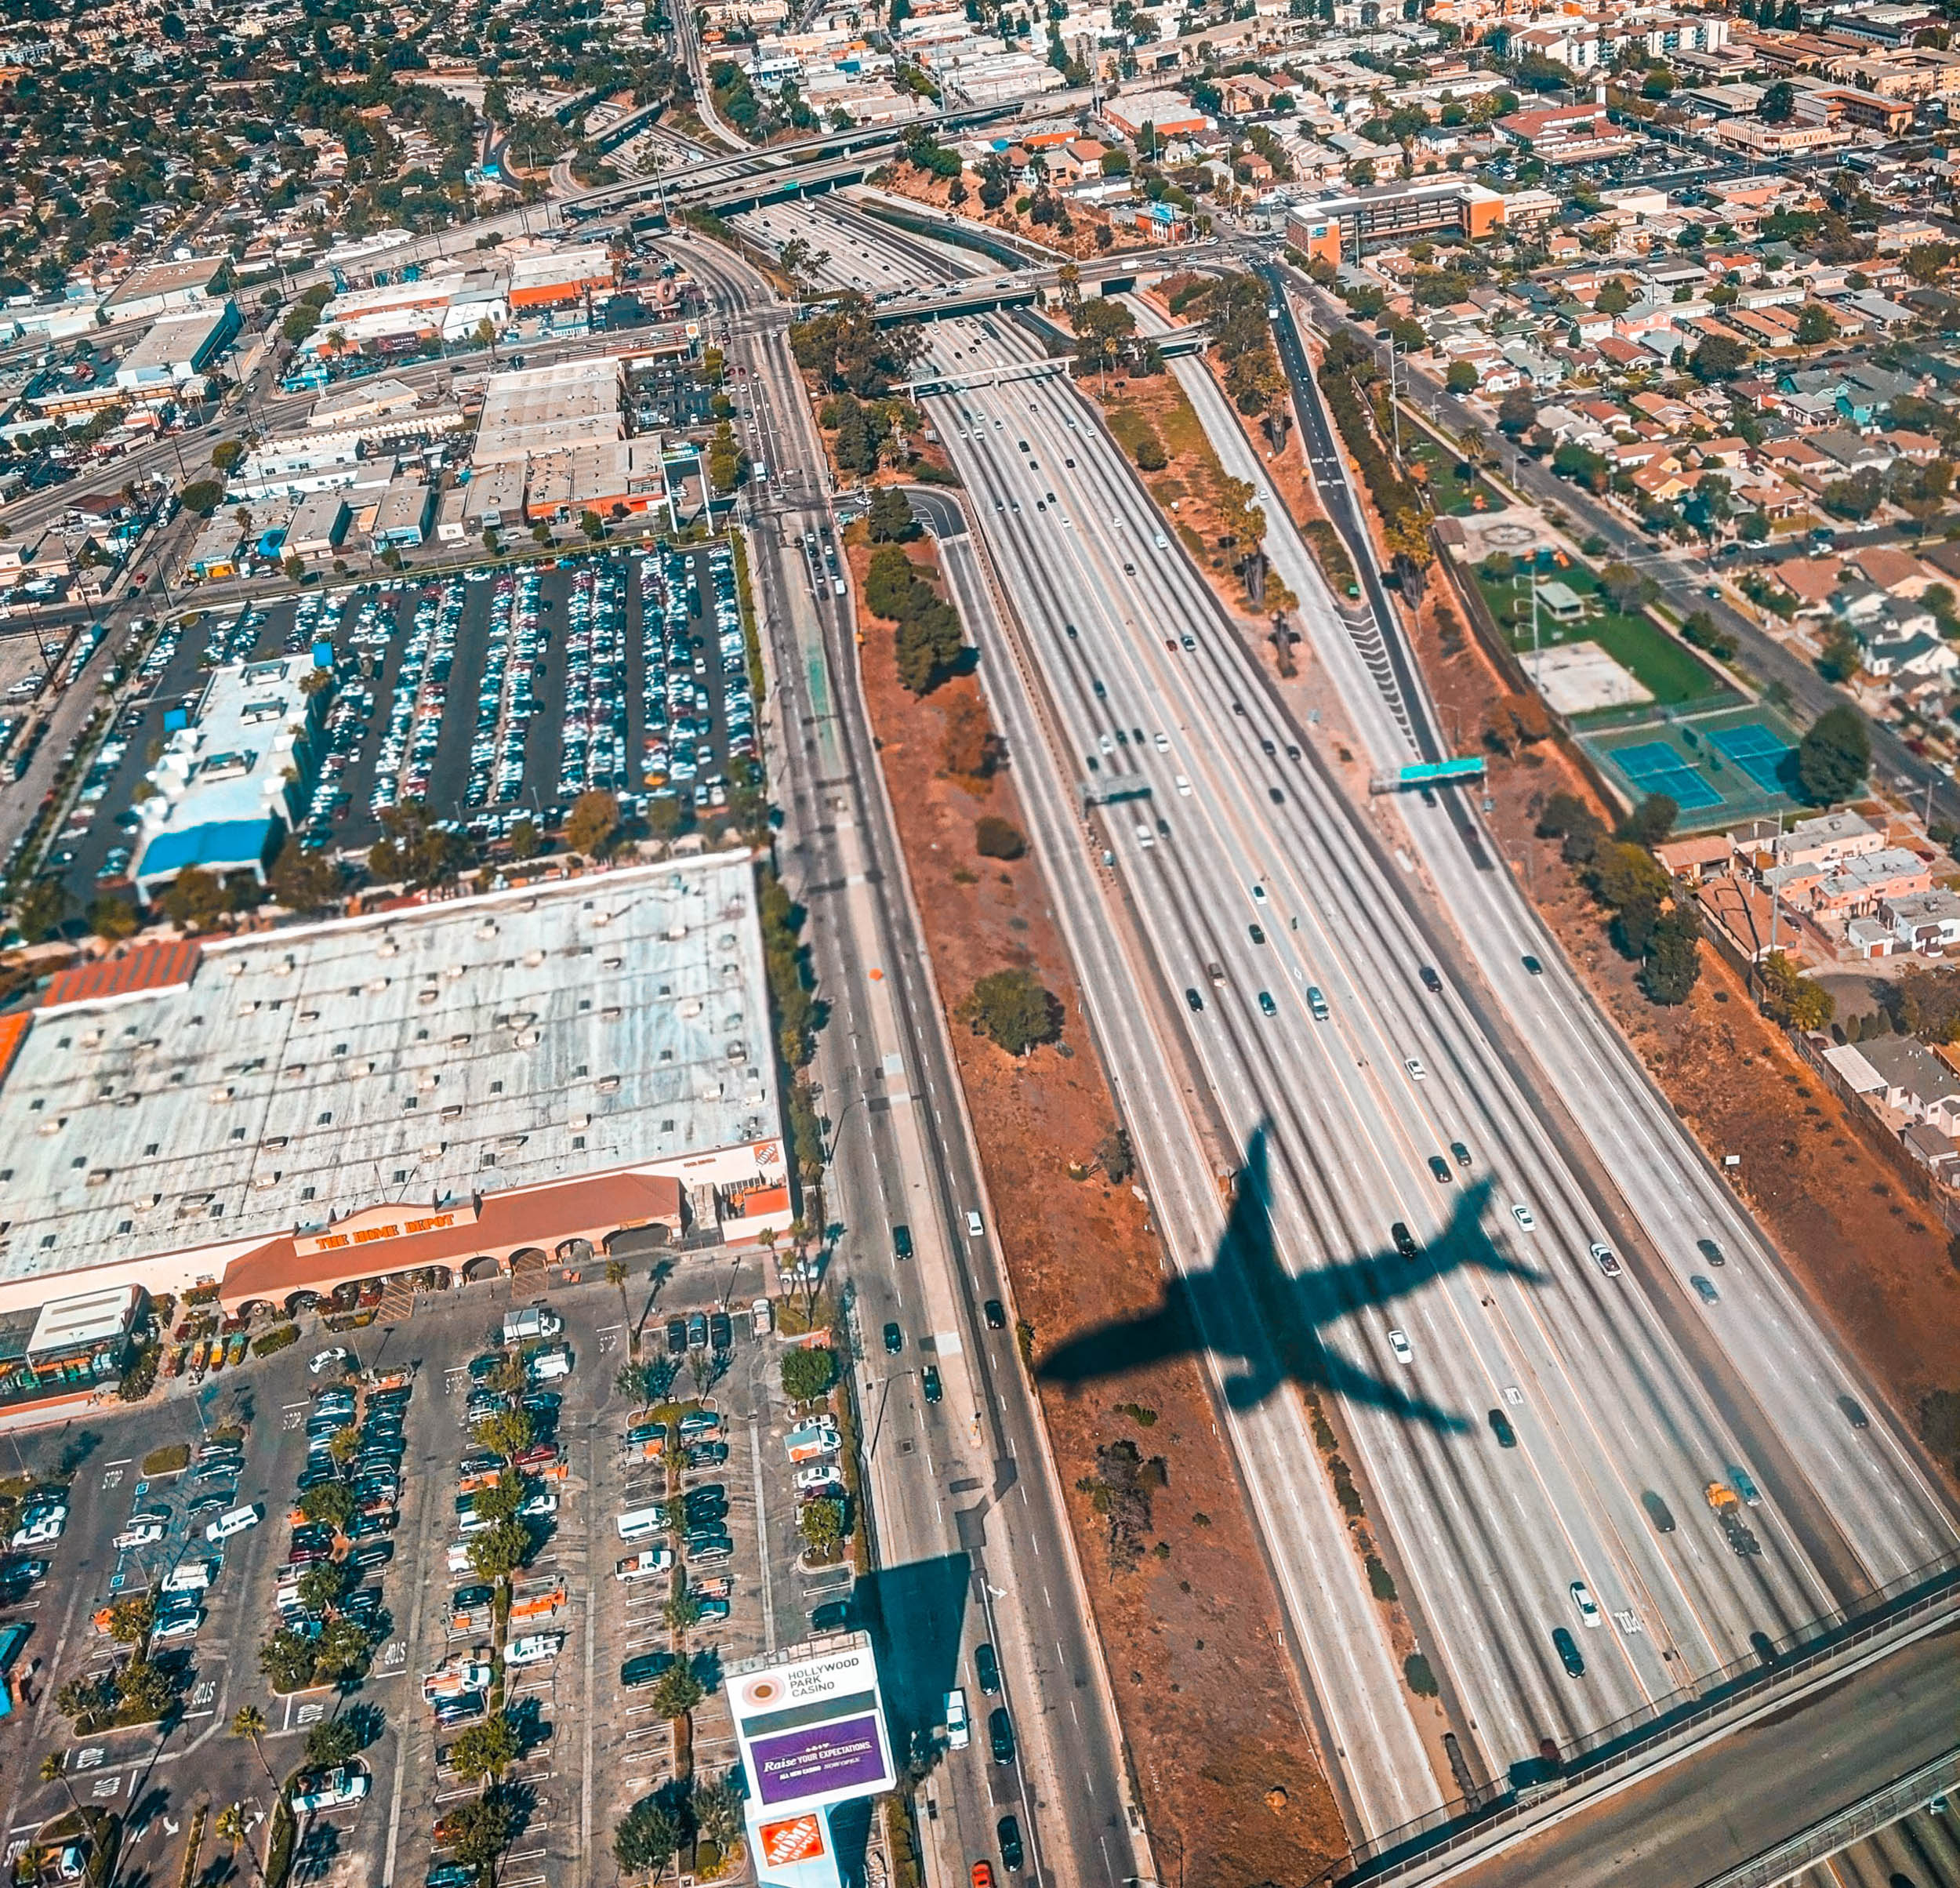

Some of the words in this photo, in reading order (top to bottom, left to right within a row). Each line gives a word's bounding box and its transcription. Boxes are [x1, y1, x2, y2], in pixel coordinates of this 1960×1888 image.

[315, 1233, 349, 1250] THE
[353, 1225, 400, 1244] HOME
[404, 1214, 454, 1233] DEPOT
[384, 1641, 406, 1665] STOP
[788, 1657, 859, 1680] HOLLYWOOD
[192, 1680, 216, 1705] STOP
[790, 1675, 821, 1689] PARK
[792, 1682, 835, 1697] CASINO
[297, 1704, 325, 1723] STOP
[76, 1748, 105, 1769] STOP
[764, 1758, 797, 1774] Raise
[797, 1752, 818, 1763] YOUR
[819, 1741, 873, 1759] EXPECTATIONS.
[92, 1777, 121, 1797] STOP
[768, 1818, 817, 1864] HOME
